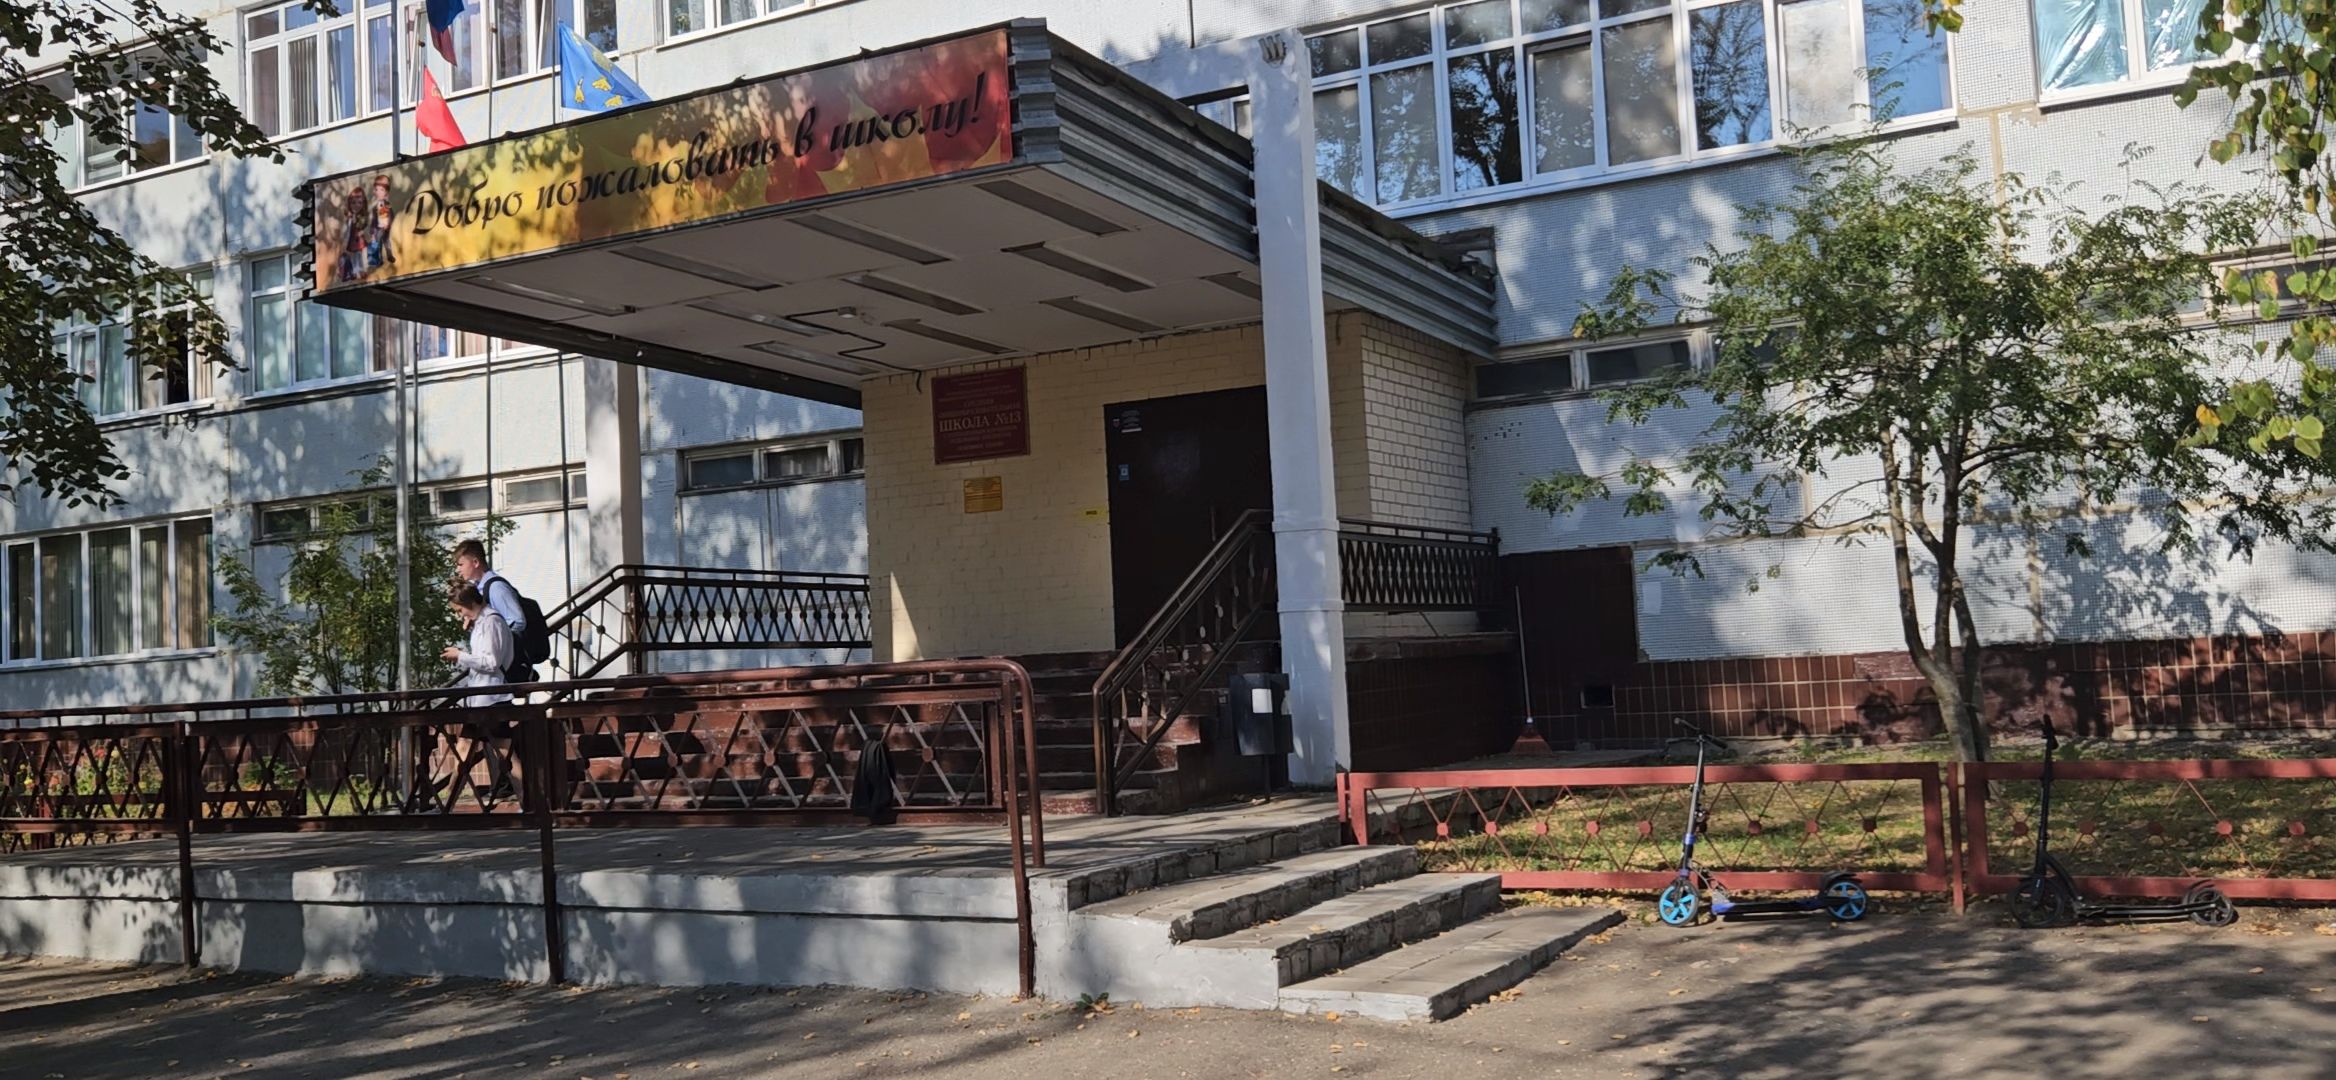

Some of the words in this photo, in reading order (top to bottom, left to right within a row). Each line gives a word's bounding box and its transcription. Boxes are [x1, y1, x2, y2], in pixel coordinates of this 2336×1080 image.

[405, 174, 523, 235] Добро
[536, 131, 780, 211] пожаловать
[794, 106, 816, 158] в
[830, 72, 986, 153] школу!
[939, 415, 990, 433] ШКОЛА
